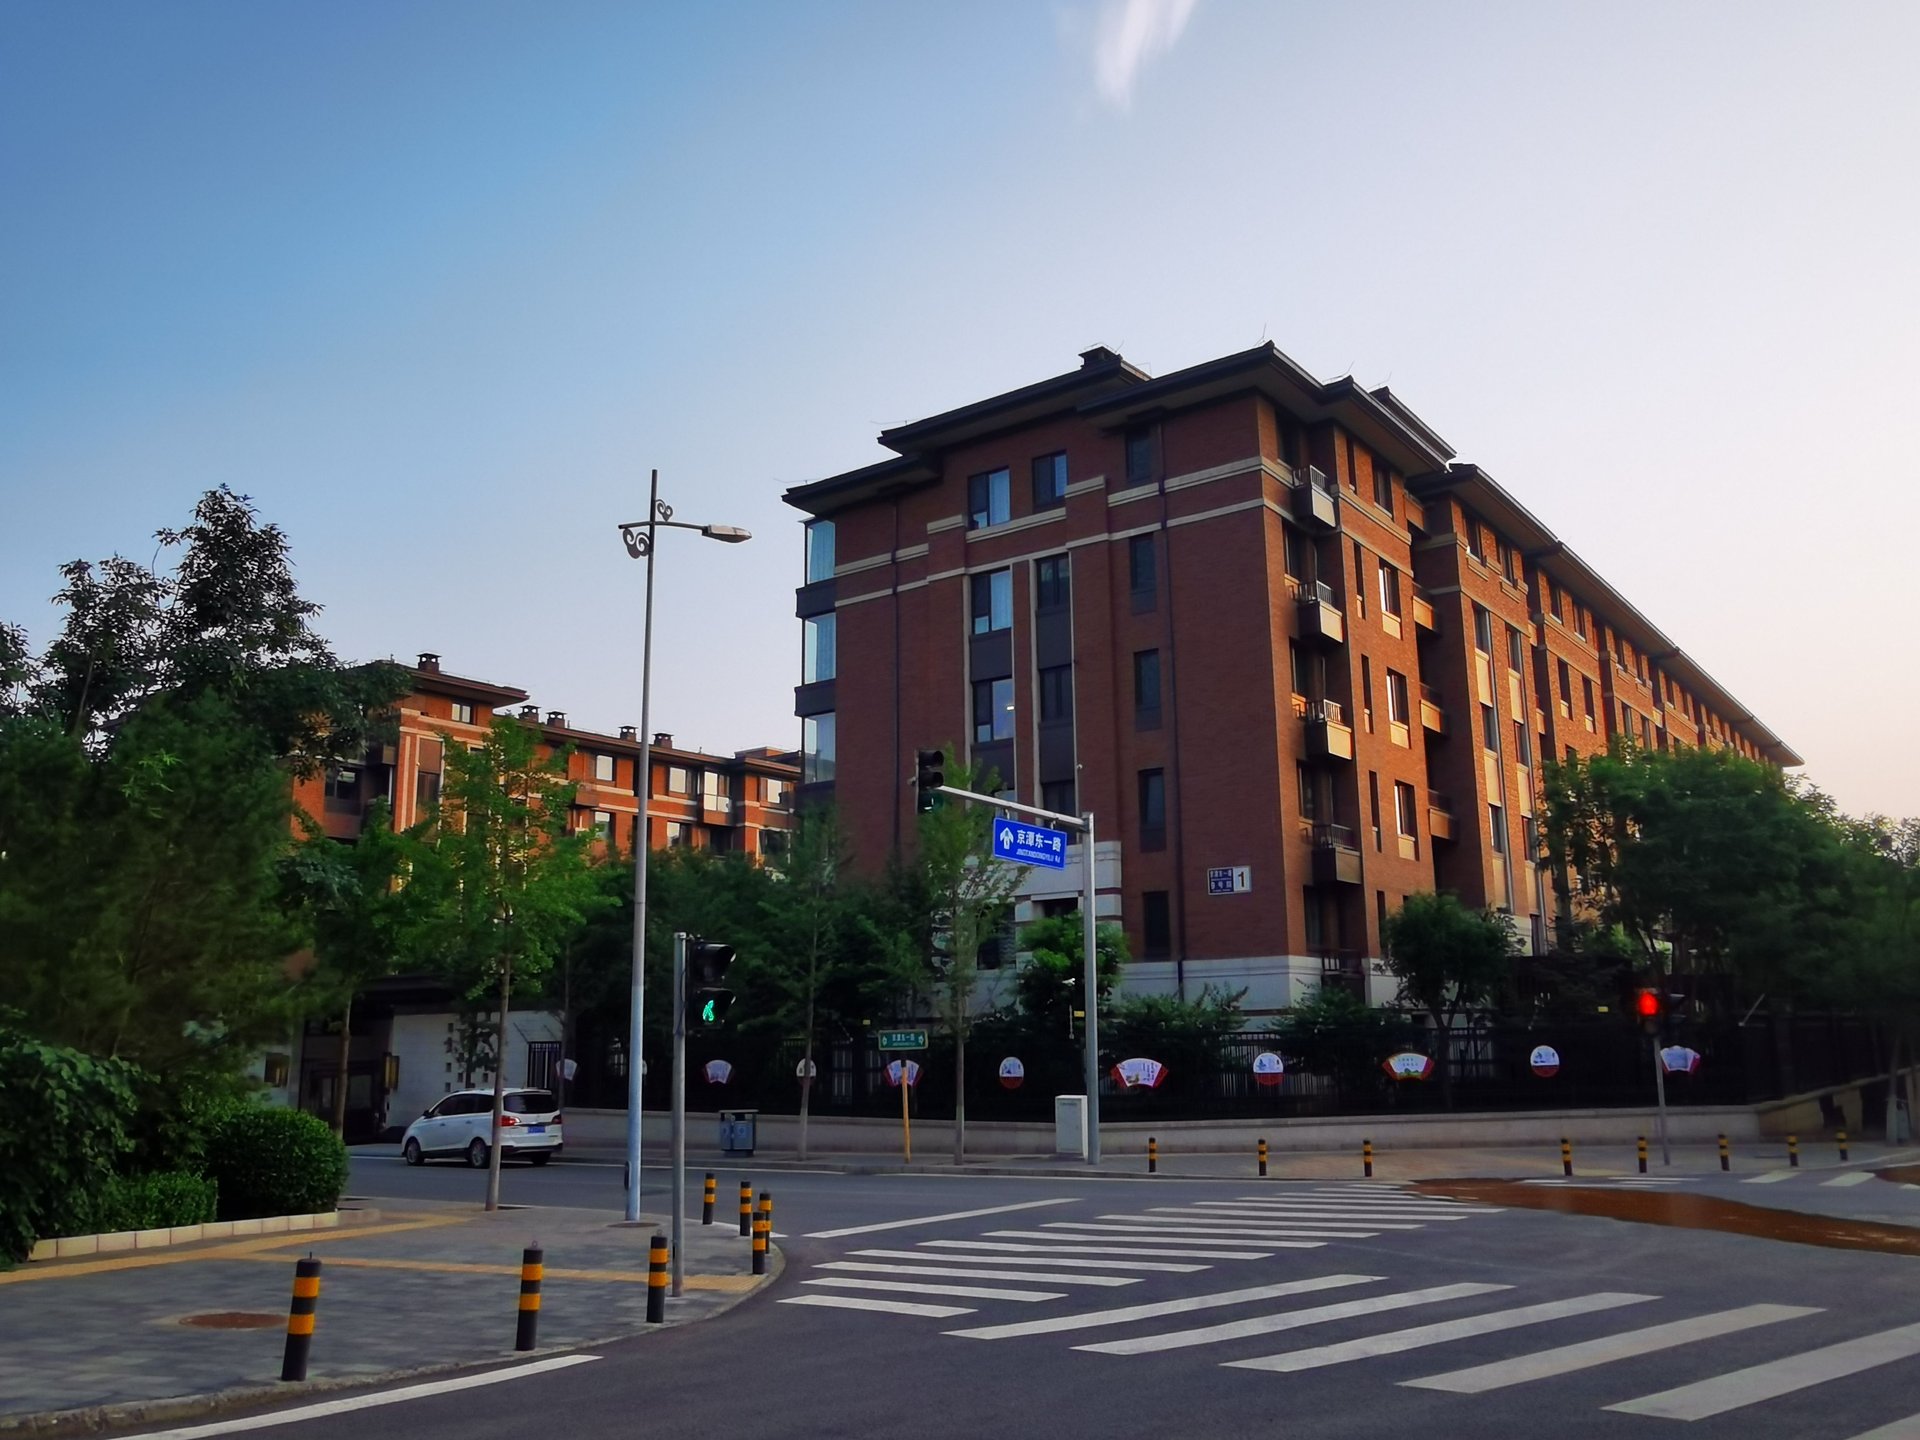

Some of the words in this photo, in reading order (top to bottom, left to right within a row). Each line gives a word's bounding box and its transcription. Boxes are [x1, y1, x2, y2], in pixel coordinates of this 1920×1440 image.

[1017, 829, 1062, 852] 京潭东一路
[1238, 871, 1245, 888] 1
